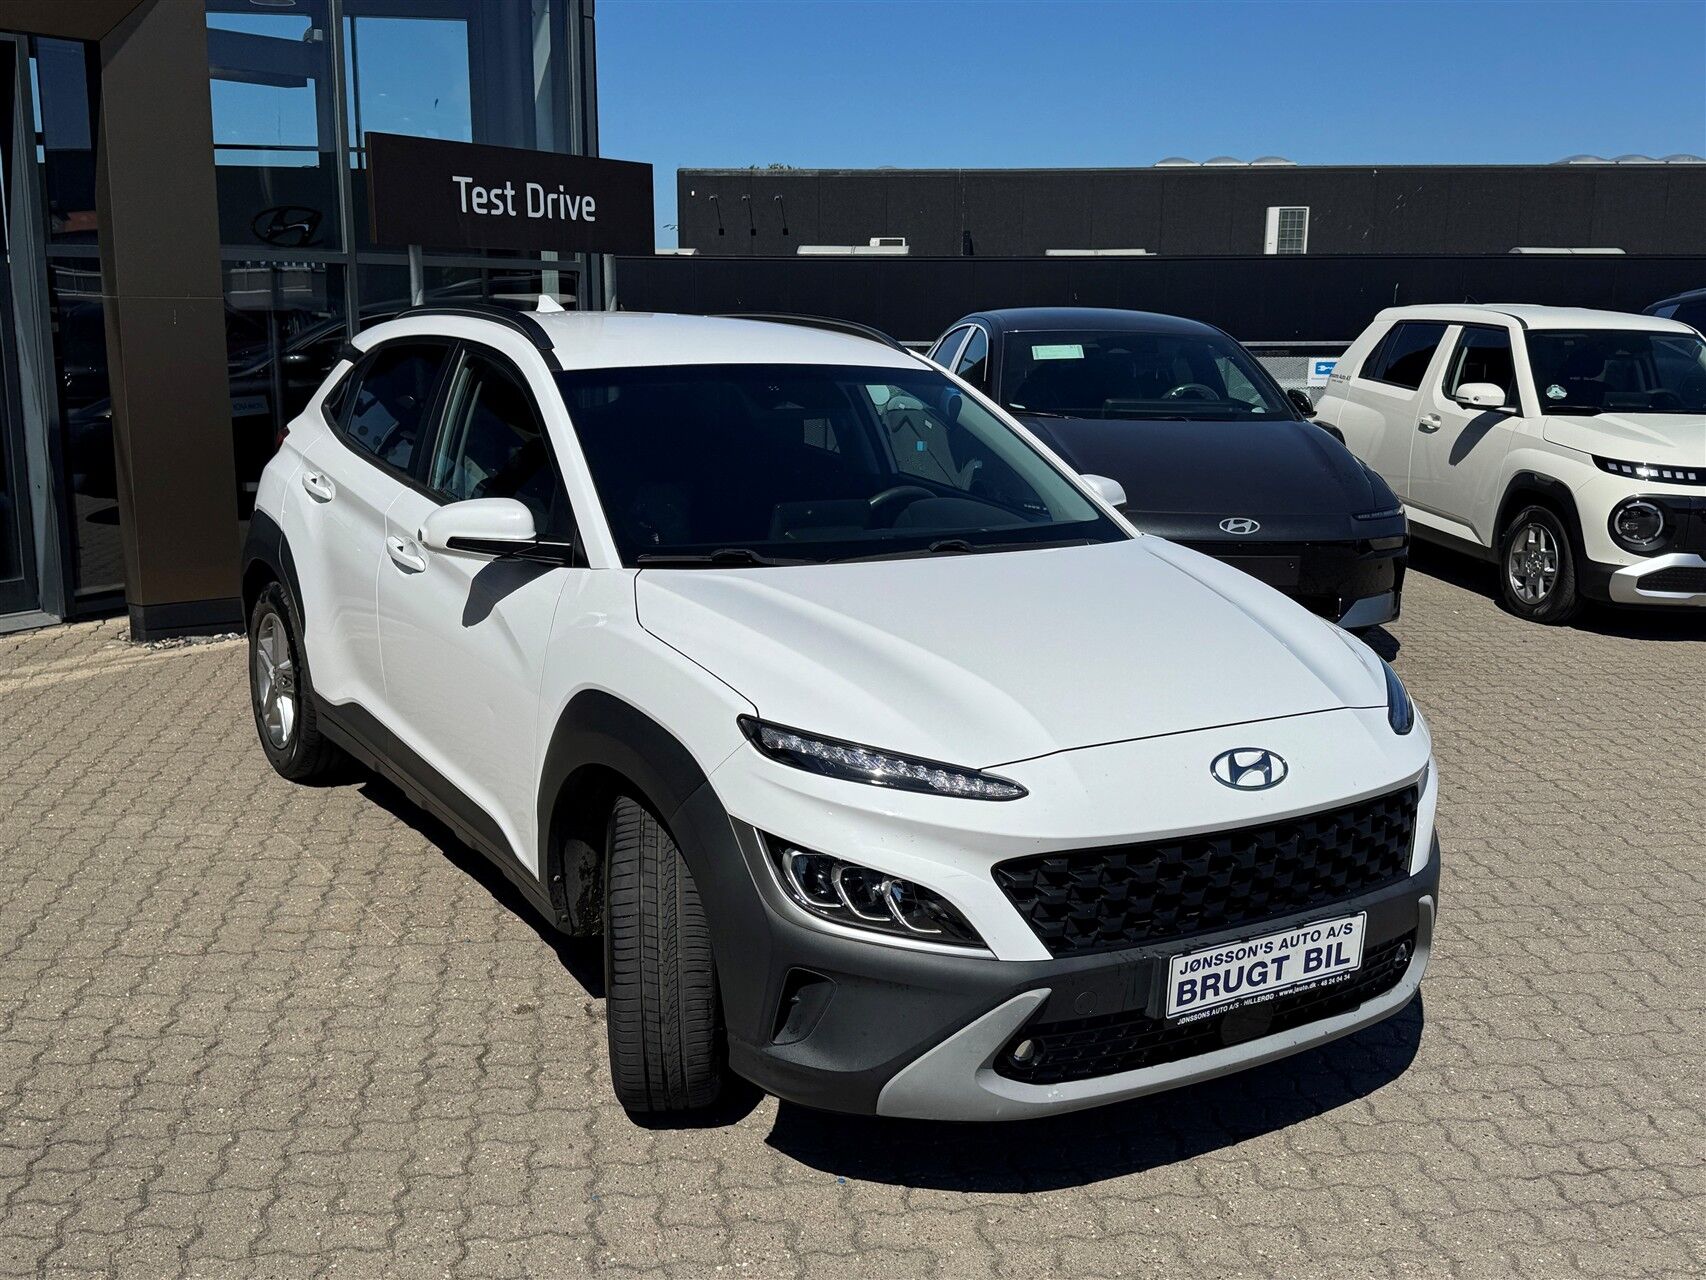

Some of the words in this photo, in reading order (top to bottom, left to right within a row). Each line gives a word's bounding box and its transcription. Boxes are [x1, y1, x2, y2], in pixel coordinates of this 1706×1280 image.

[452, 175, 517, 217] Test
[526, 182, 596, 222] Drive
[1179, 940, 1274, 975] JØNSSON'S
[1278, 929, 1321, 951] AUTO
[1326, 922, 1353, 939] A/S
[1176, 955, 1290, 1008] BRUGT
[1303, 941, 1351, 974] BIL
[1177, 1010, 1211, 1025] JØNSSONS
[1211, 1005, 1228, 1016] AUTO
[1229, 1002, 1239, 1010] A/S
[1243, 993, 1275, 1005] HILLERØD
[1279, 982, 1317, 996] www.jauto.dk
